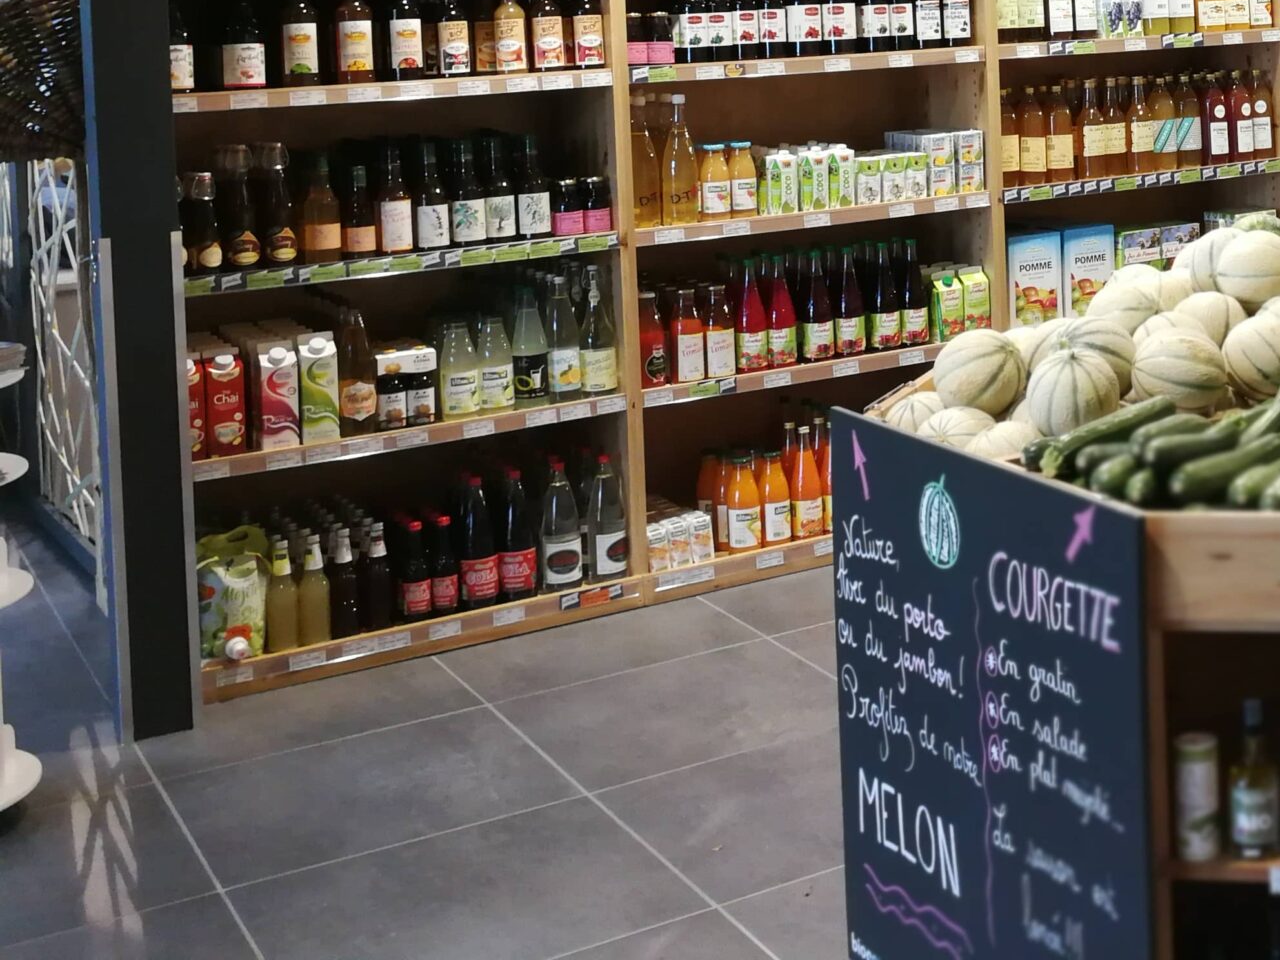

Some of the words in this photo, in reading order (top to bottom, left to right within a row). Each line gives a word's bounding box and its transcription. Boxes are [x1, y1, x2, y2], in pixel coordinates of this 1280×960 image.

[1019, 261, 1053, 273] POMME
[1074, 253, 1107, 265] POMME
[213, 393, 239, 405] Chai
[875, 579, 899, 619] du
[903, 593, 952, 643] porto
[988, 551, 1122, 654] COURGETTE
[838, 618, 858, 648] ou
[865, 619, 888, 662] du
[998, 639, 1021, 680] En
[1029, 658, 1081, 705] gratin
[842, 664, 915, 772] Profitez
[919, 714, 939, 755] de
[943, 737, 982, 787] notre
[1000, 693, 1025, 730] En
[1032, 716, 1087, 762] salade
[1000, 739, 1022, 772] En
[858, 767, 961, 899] MELON
